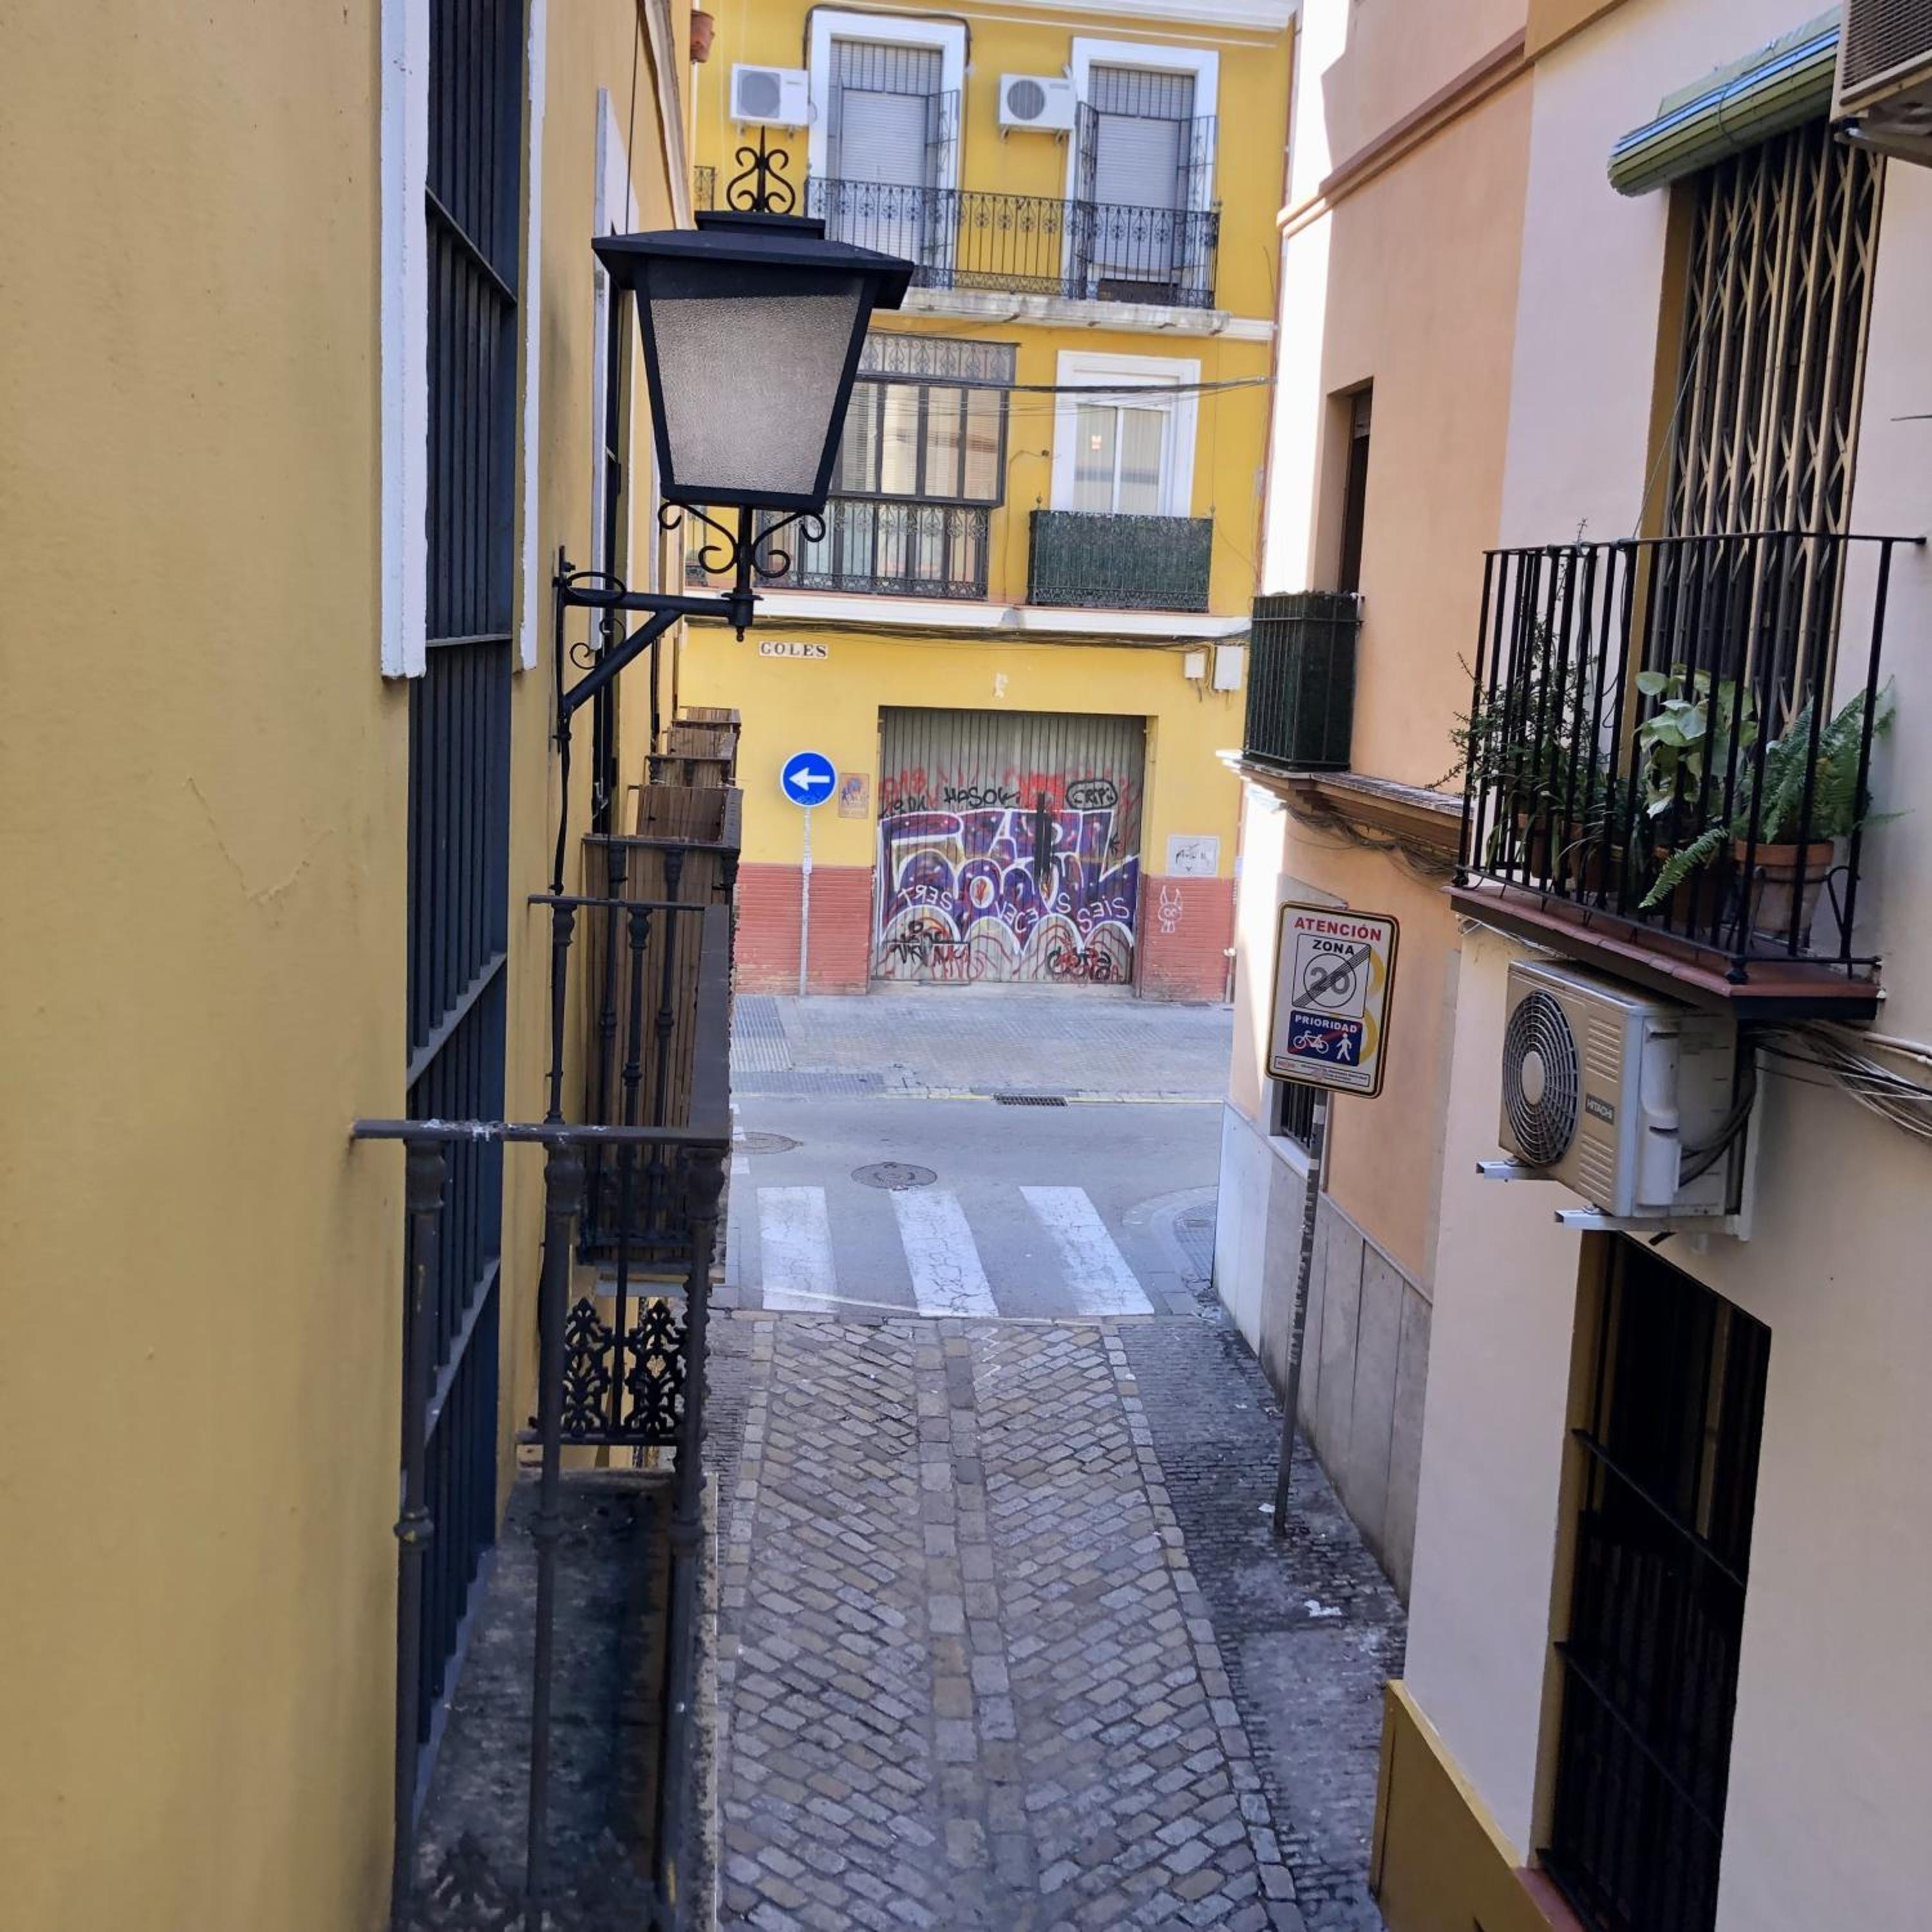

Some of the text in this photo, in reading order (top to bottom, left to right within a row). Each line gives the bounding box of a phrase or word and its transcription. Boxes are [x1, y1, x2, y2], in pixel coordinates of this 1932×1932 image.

[761, 642, 826, 658] GOLES
[1294, 916, 1382, 942] ATENCIÓN
[1312, 939, 1354, 955] ZONA
[1294, 1014, 1358, 1034] PRIORIDAD
